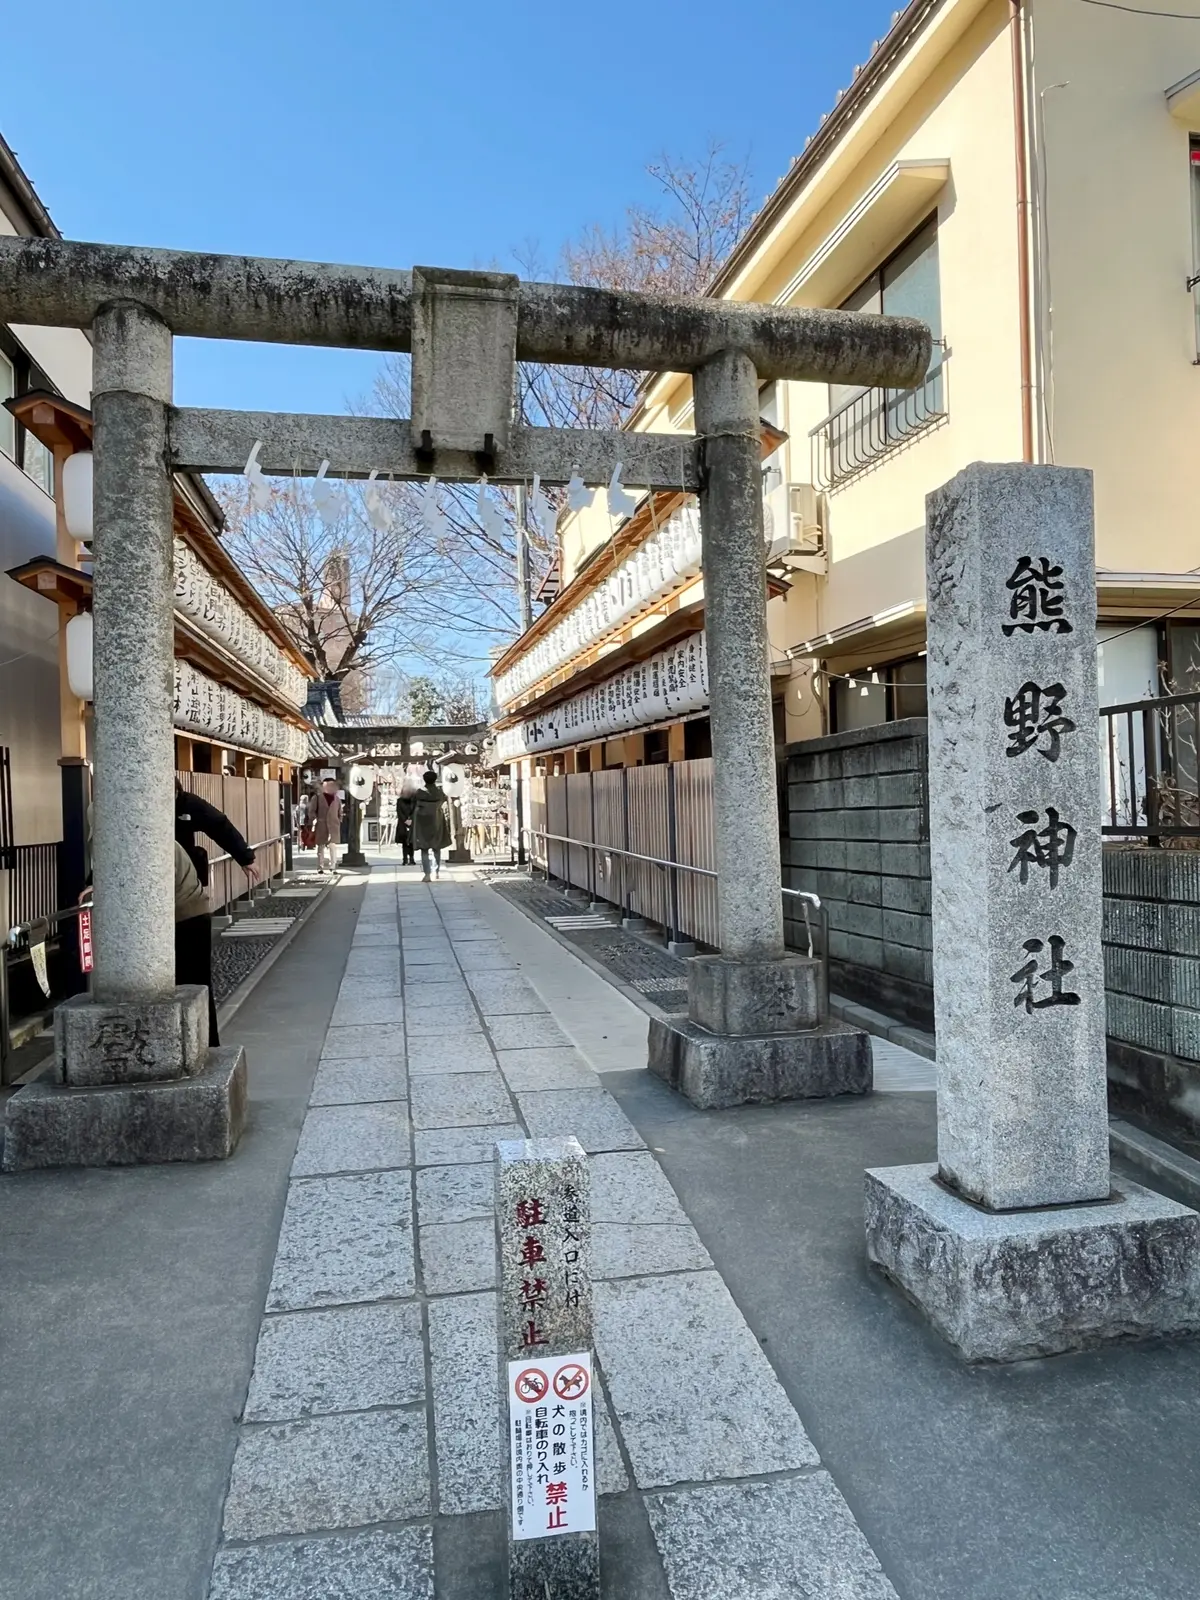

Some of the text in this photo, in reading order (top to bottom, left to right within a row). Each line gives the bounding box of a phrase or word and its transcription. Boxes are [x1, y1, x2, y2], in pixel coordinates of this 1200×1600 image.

[1001, 555, 1081, 1016] 熊野神社
[516, 1197, 550, 1349] 駐車禁止
[535, 1406, 550, 1485] 自転車のり入れ
[552, 1404, 567, 1476] 犬の散歩
[545, 1480, 569, 1530] 禁止
